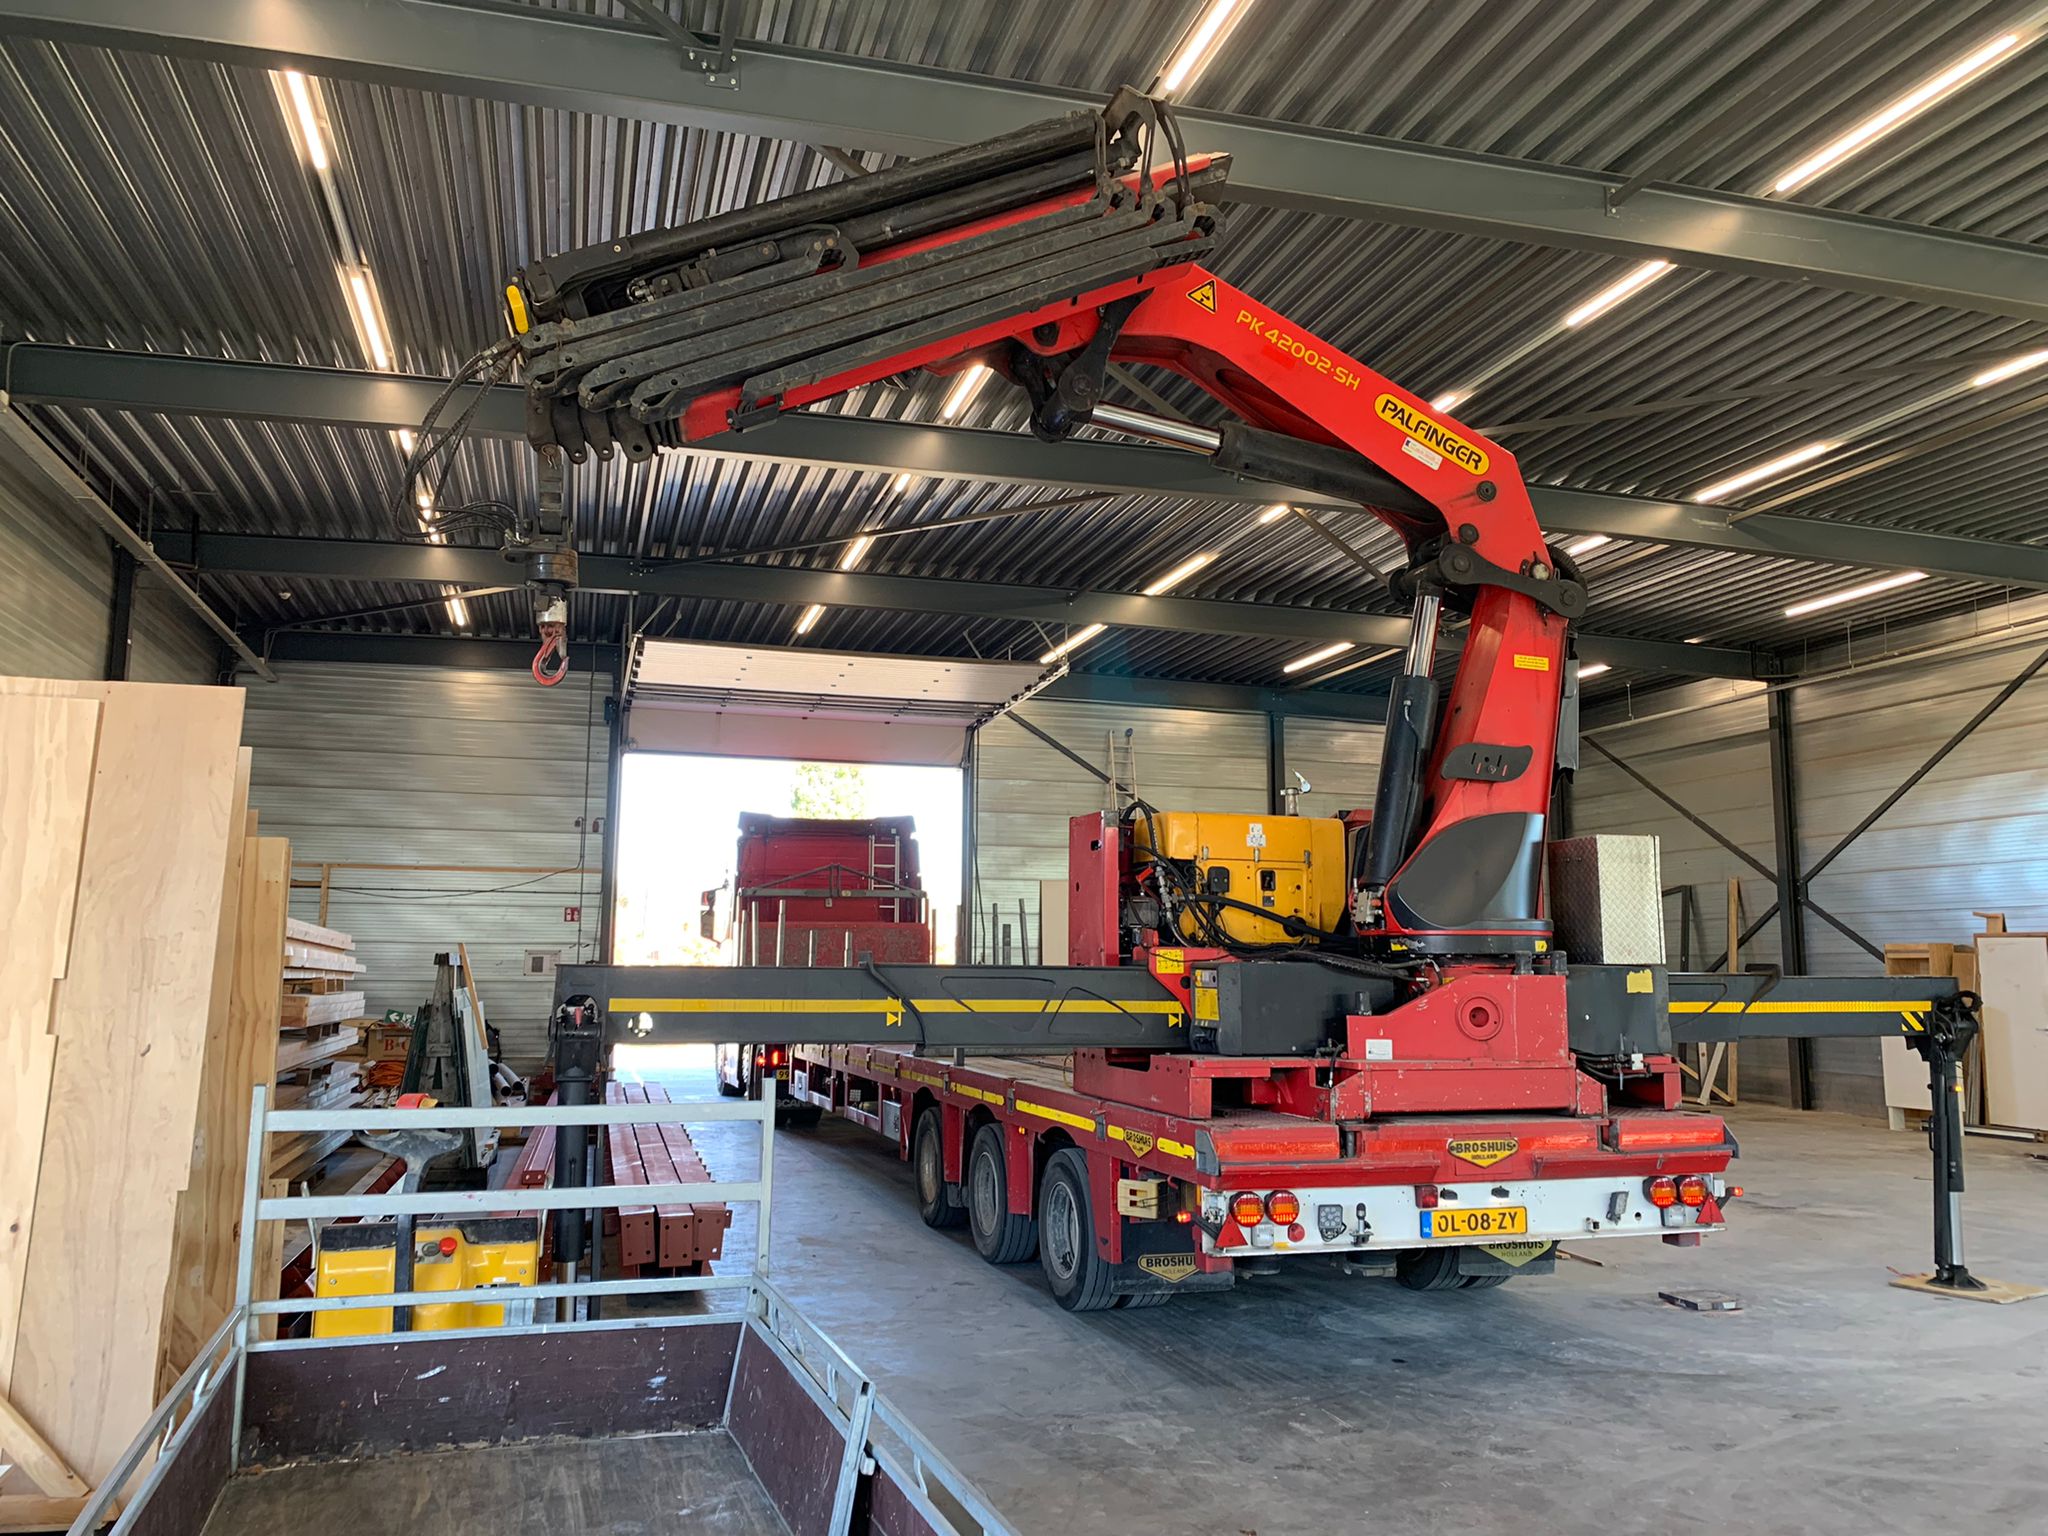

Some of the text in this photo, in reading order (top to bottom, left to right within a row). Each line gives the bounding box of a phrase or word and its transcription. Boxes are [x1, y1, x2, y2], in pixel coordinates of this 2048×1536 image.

[1236, 309, 1265, 336] PK
[1381, 399, 1483, 471] PALFINGER
[1455, 1141, 1513, 1154] BROSHUIS
[1437, 1211, 1518, 1233] OL-08-ZY
[1488, 1240, 1545, 1250] BROSHUIS
[1501, 1250, 1533, 1258] HOLLAND
[1146, 1256, 1197, 1268] BROSHUI
